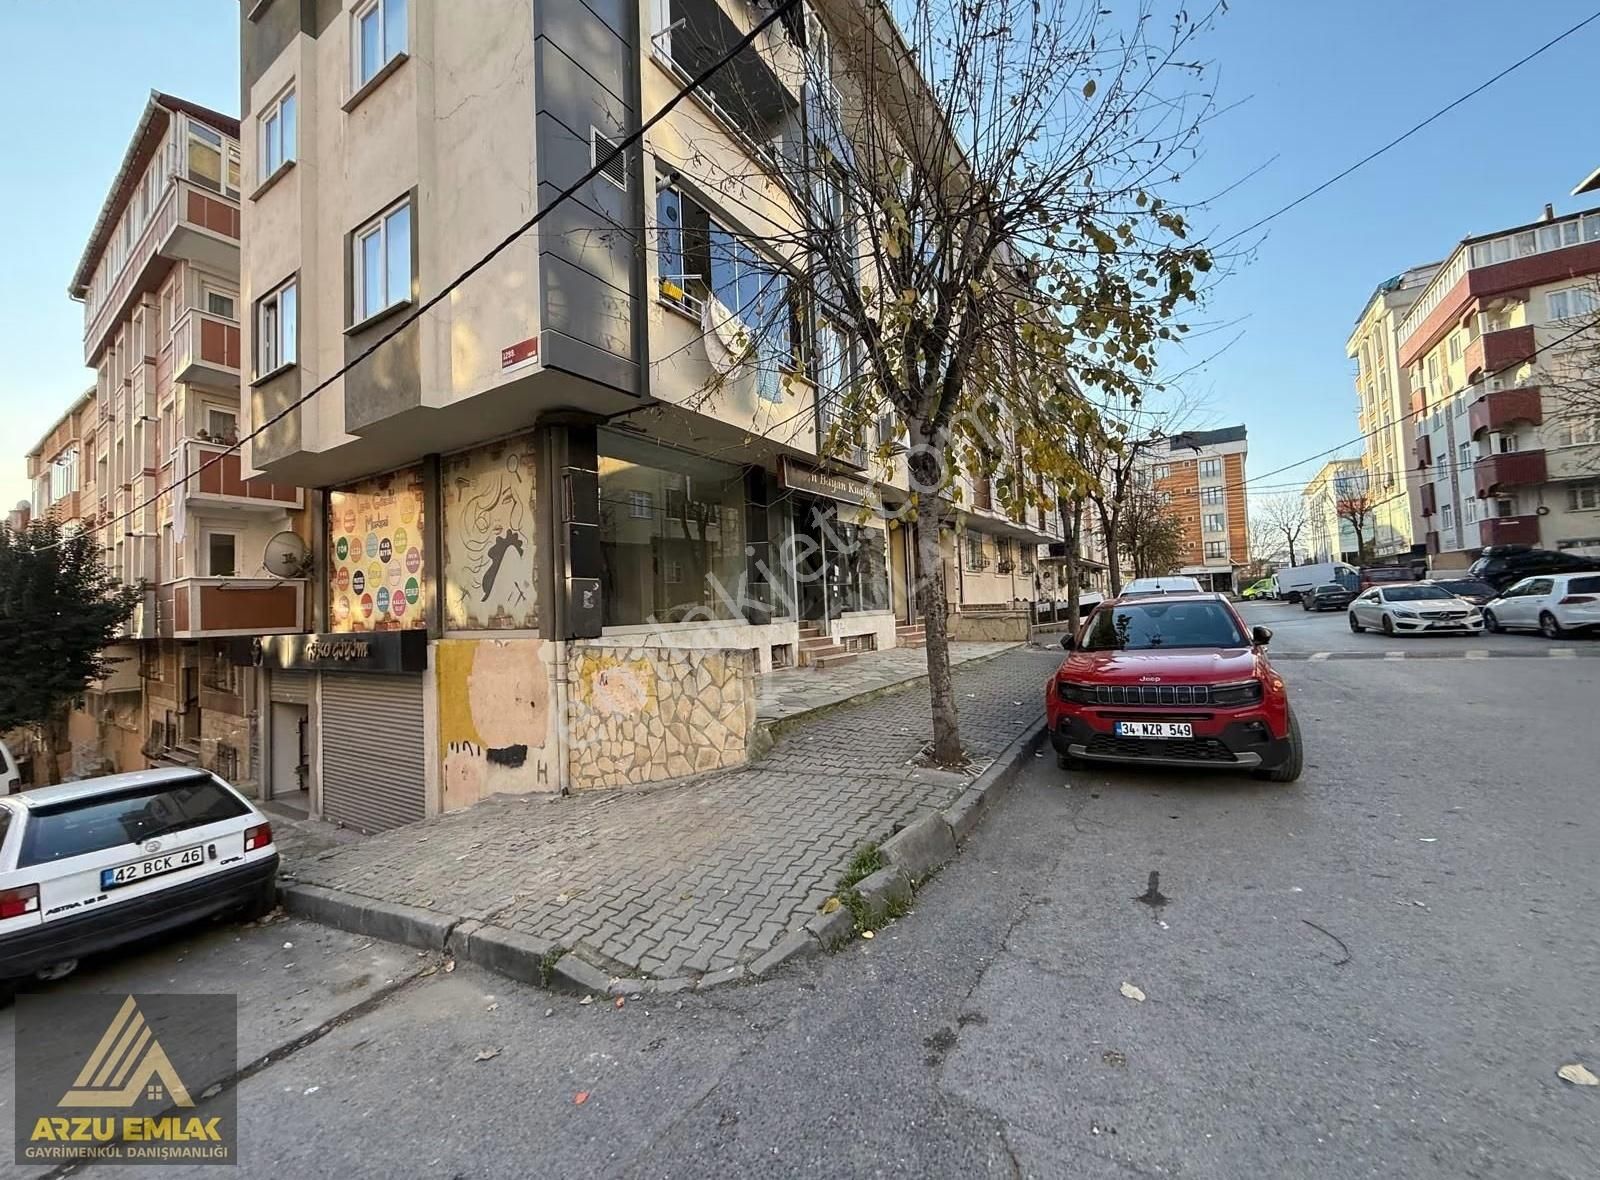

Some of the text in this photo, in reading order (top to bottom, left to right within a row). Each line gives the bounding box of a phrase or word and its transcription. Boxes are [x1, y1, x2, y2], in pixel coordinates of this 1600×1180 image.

[1122, 723, 1191, 736] 34 NZR 549
[115, 849, 201, 884] 42 BCK 46
